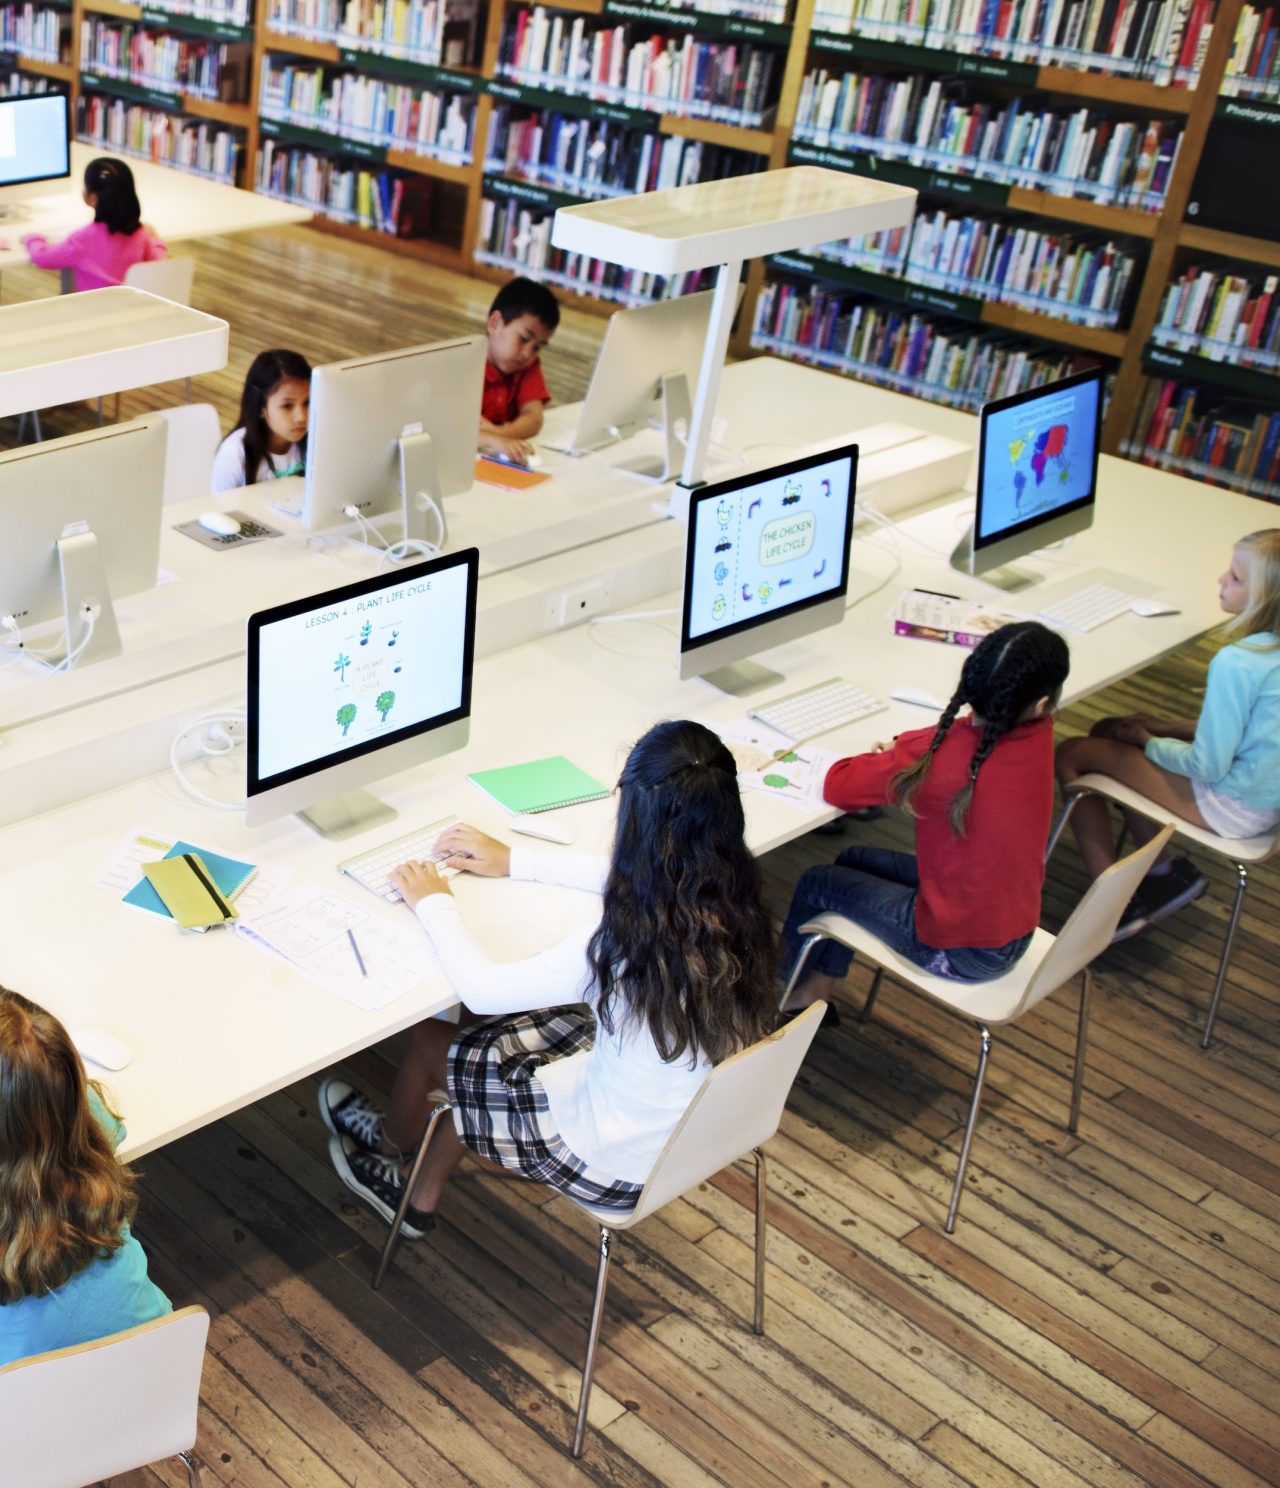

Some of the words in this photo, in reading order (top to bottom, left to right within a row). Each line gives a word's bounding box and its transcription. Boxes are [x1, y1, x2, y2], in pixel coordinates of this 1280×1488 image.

[1188, 201, 1200, 216] 6
[763, 530, 778, 543] THE
[779, 520, 812, 538] CHICKEN
[766, 545, 782, 559] LIFE
[783, 537, 806, 553] CYCLE
[305, 610, 340, 629] LESSON
[356, 596, 383, 613] PLANT
[386, 590, 404, 604] LIFE
[407, 581, 432, 597] CYCLE
